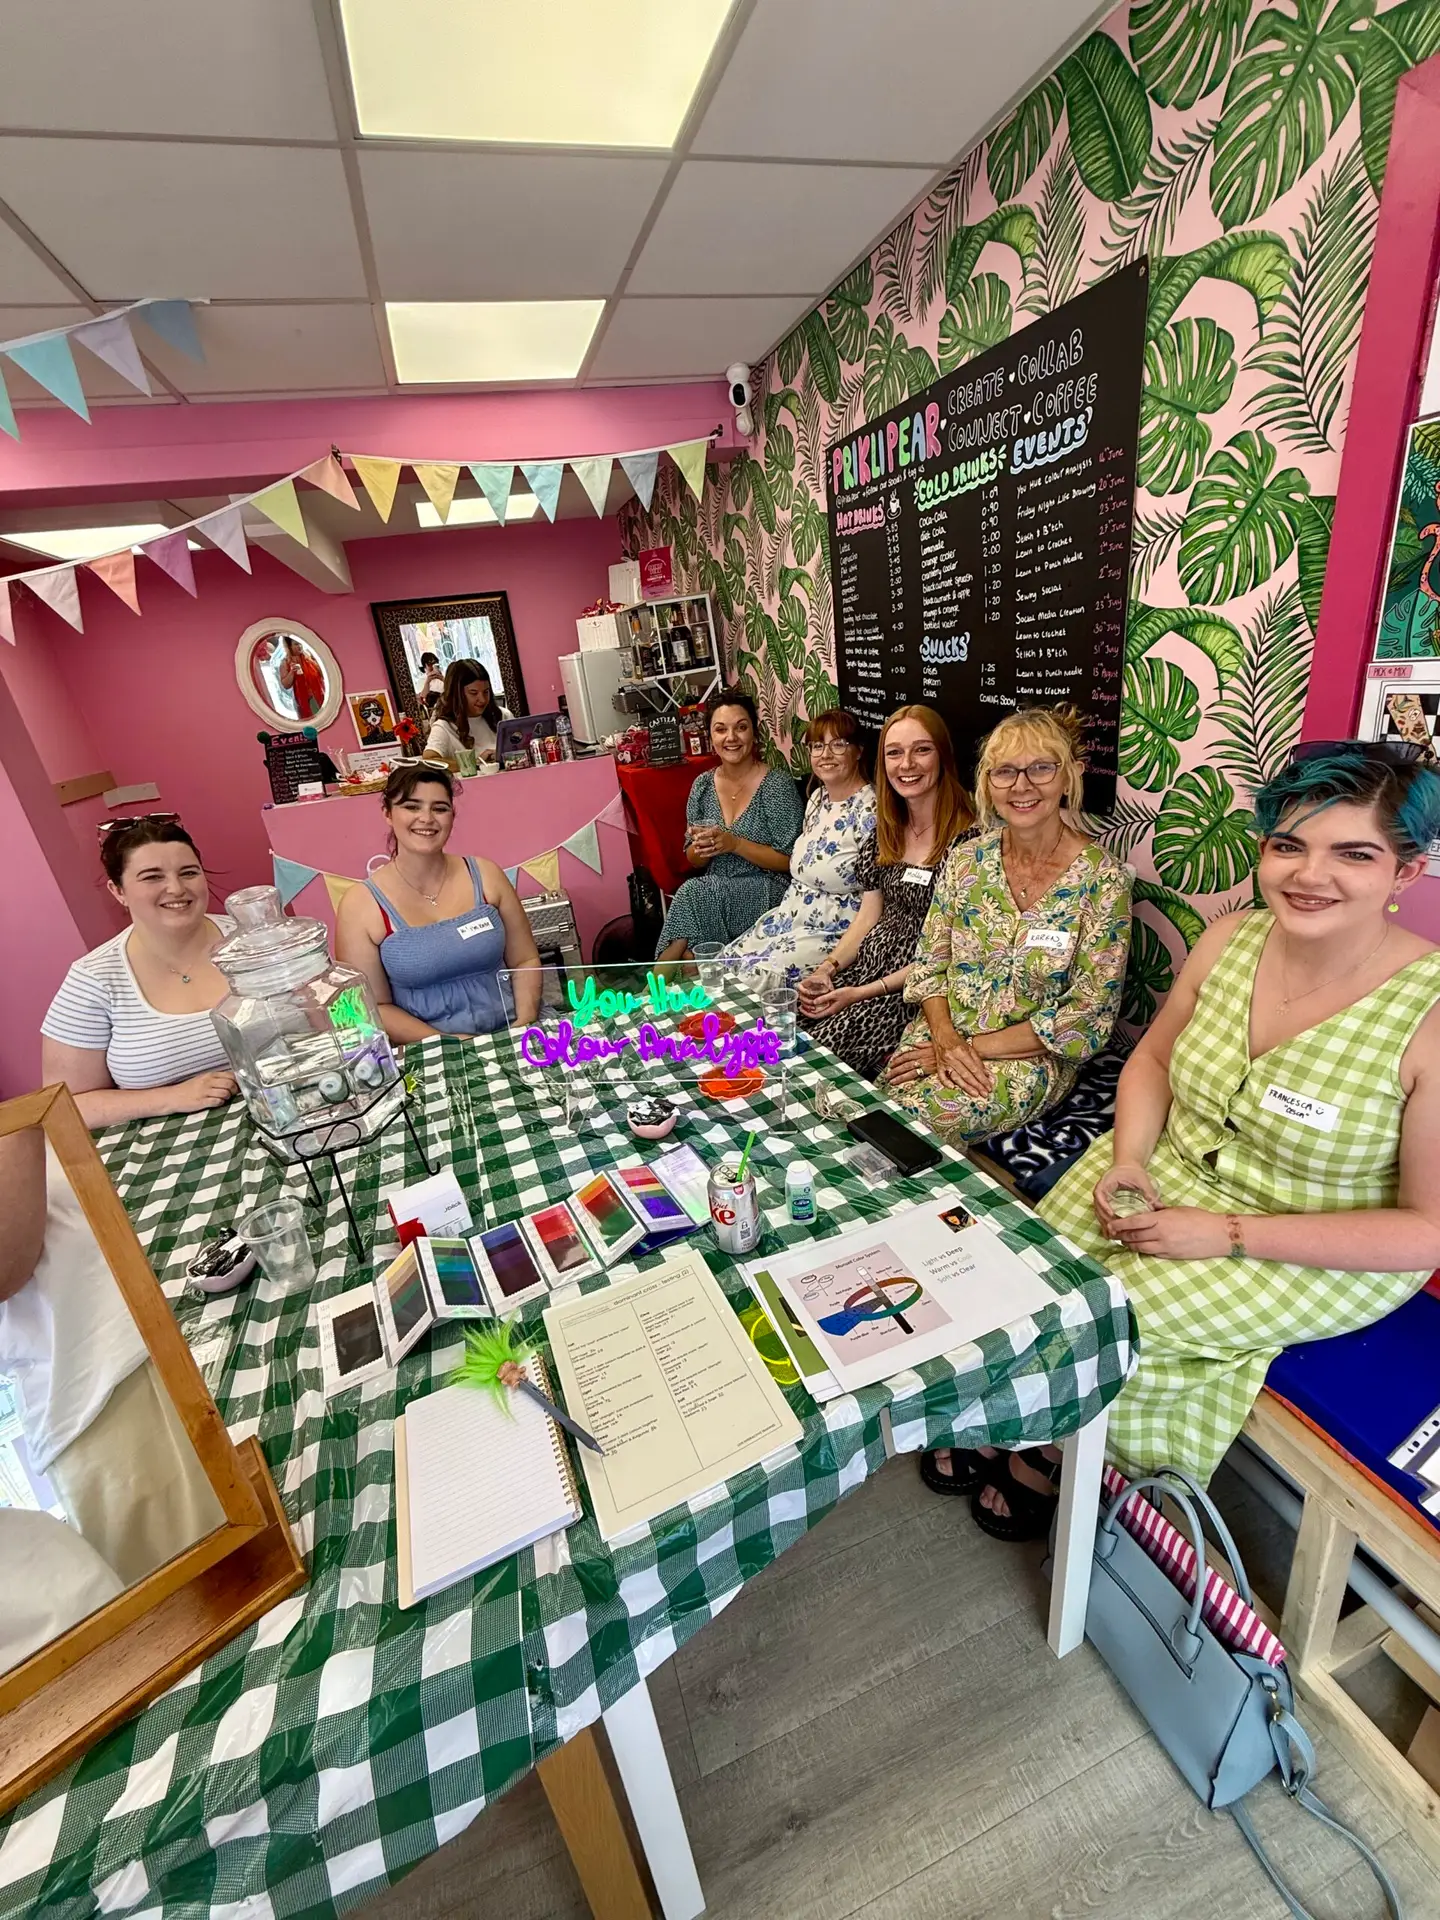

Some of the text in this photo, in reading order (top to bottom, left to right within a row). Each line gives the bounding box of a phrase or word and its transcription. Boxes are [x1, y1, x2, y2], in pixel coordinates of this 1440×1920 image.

[948, 328, 1084, 416] CREATE COLLAB
[948, 373, 1098, 451] CONNECT COFFEE
[1013, 413, 1087, 466] EVENTS
[919, 447, 998, 502] COLD DRINKS
[836, 504, 884, 530] HOT DRINKS
[982, 531, 1000, 544] 2.00
[983, 543, 1001, 557] 2.00
[922, 635, 968, 657] SNACKS
[981, 663, 996, 673] 1.25
[981, 677, 996, 687] 1.25
[568, 971, 714, 1028] You Hue
[521, 1013, 782, 1078] Colour Analysis
[1268, 1088, 1312, 1111] FRANCESCA
[709, 1197, 736, 1226] ke
[865, 1249, 881, 1258] System
[921, 1257, 939, 1267] Light
[945, 1246, 963, 1256] Deep
[929, 1264, 950, 1275] Warm
[959, 1264, 976, 1274] Clear
[613, 1289, 642, 1306] dominant
[643, 1284, 658, 1293] cross
[661, 1273, 681, 1285] testing
